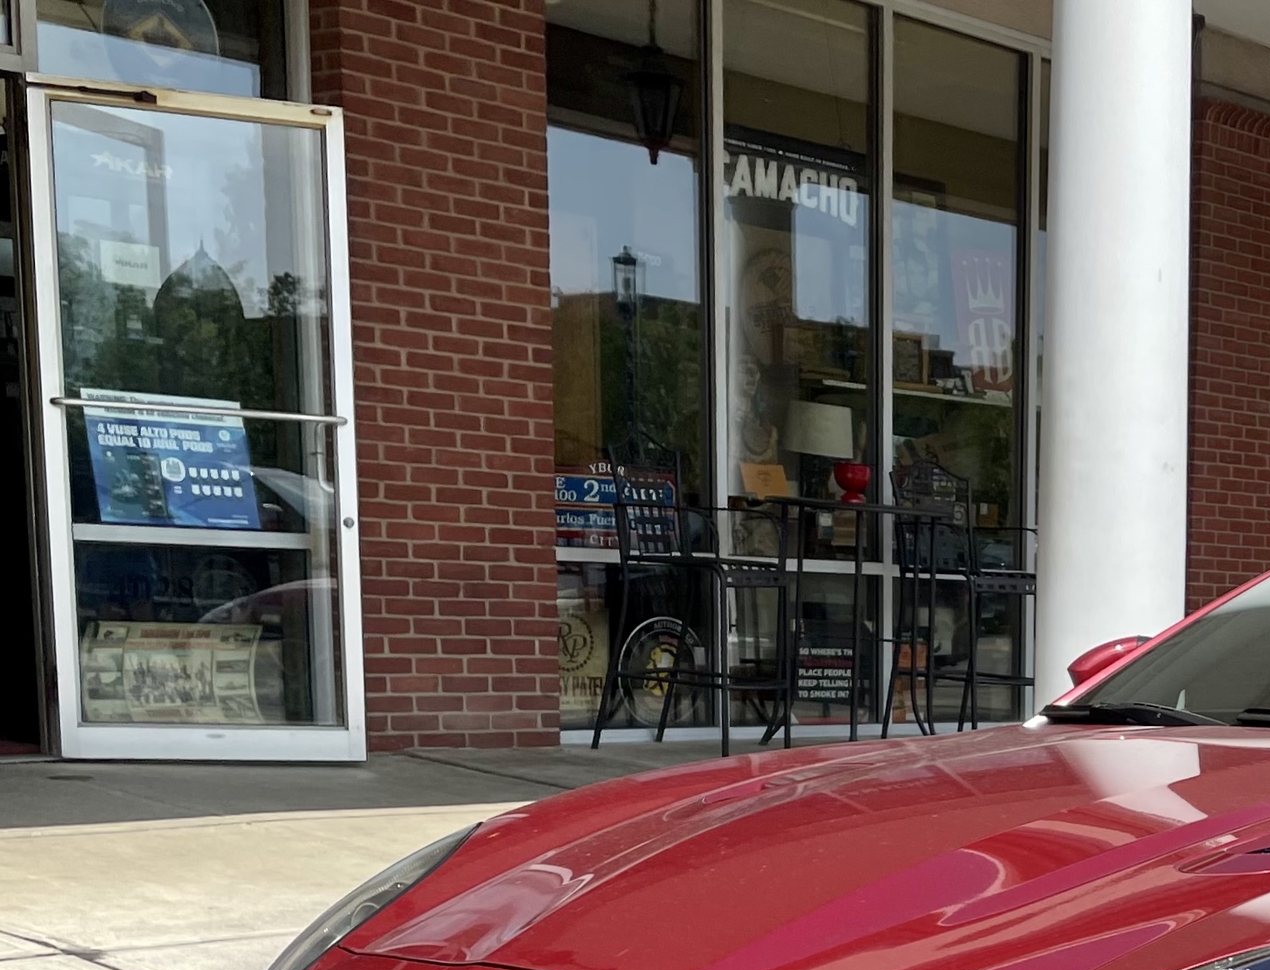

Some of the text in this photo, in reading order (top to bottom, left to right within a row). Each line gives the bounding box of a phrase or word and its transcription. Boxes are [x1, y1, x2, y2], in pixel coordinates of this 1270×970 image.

[724, 150, 859, 227] AMACHO
[97, 423, 201, 441] 4 VUSE ALTO PODS
[98, 434, 136, 448] EQUAL
[182, 441, 214, 454] PODS
[810, 648, 842, 656] WHERE'S
[823, 669, 852, 677] PEOPLE
[798, 679, 818, 687] KEEP
[818, 679, 849, 687] TELLING
[798, 690, 808, 698] TO
[809, 690, 836, 698] SMOKE
